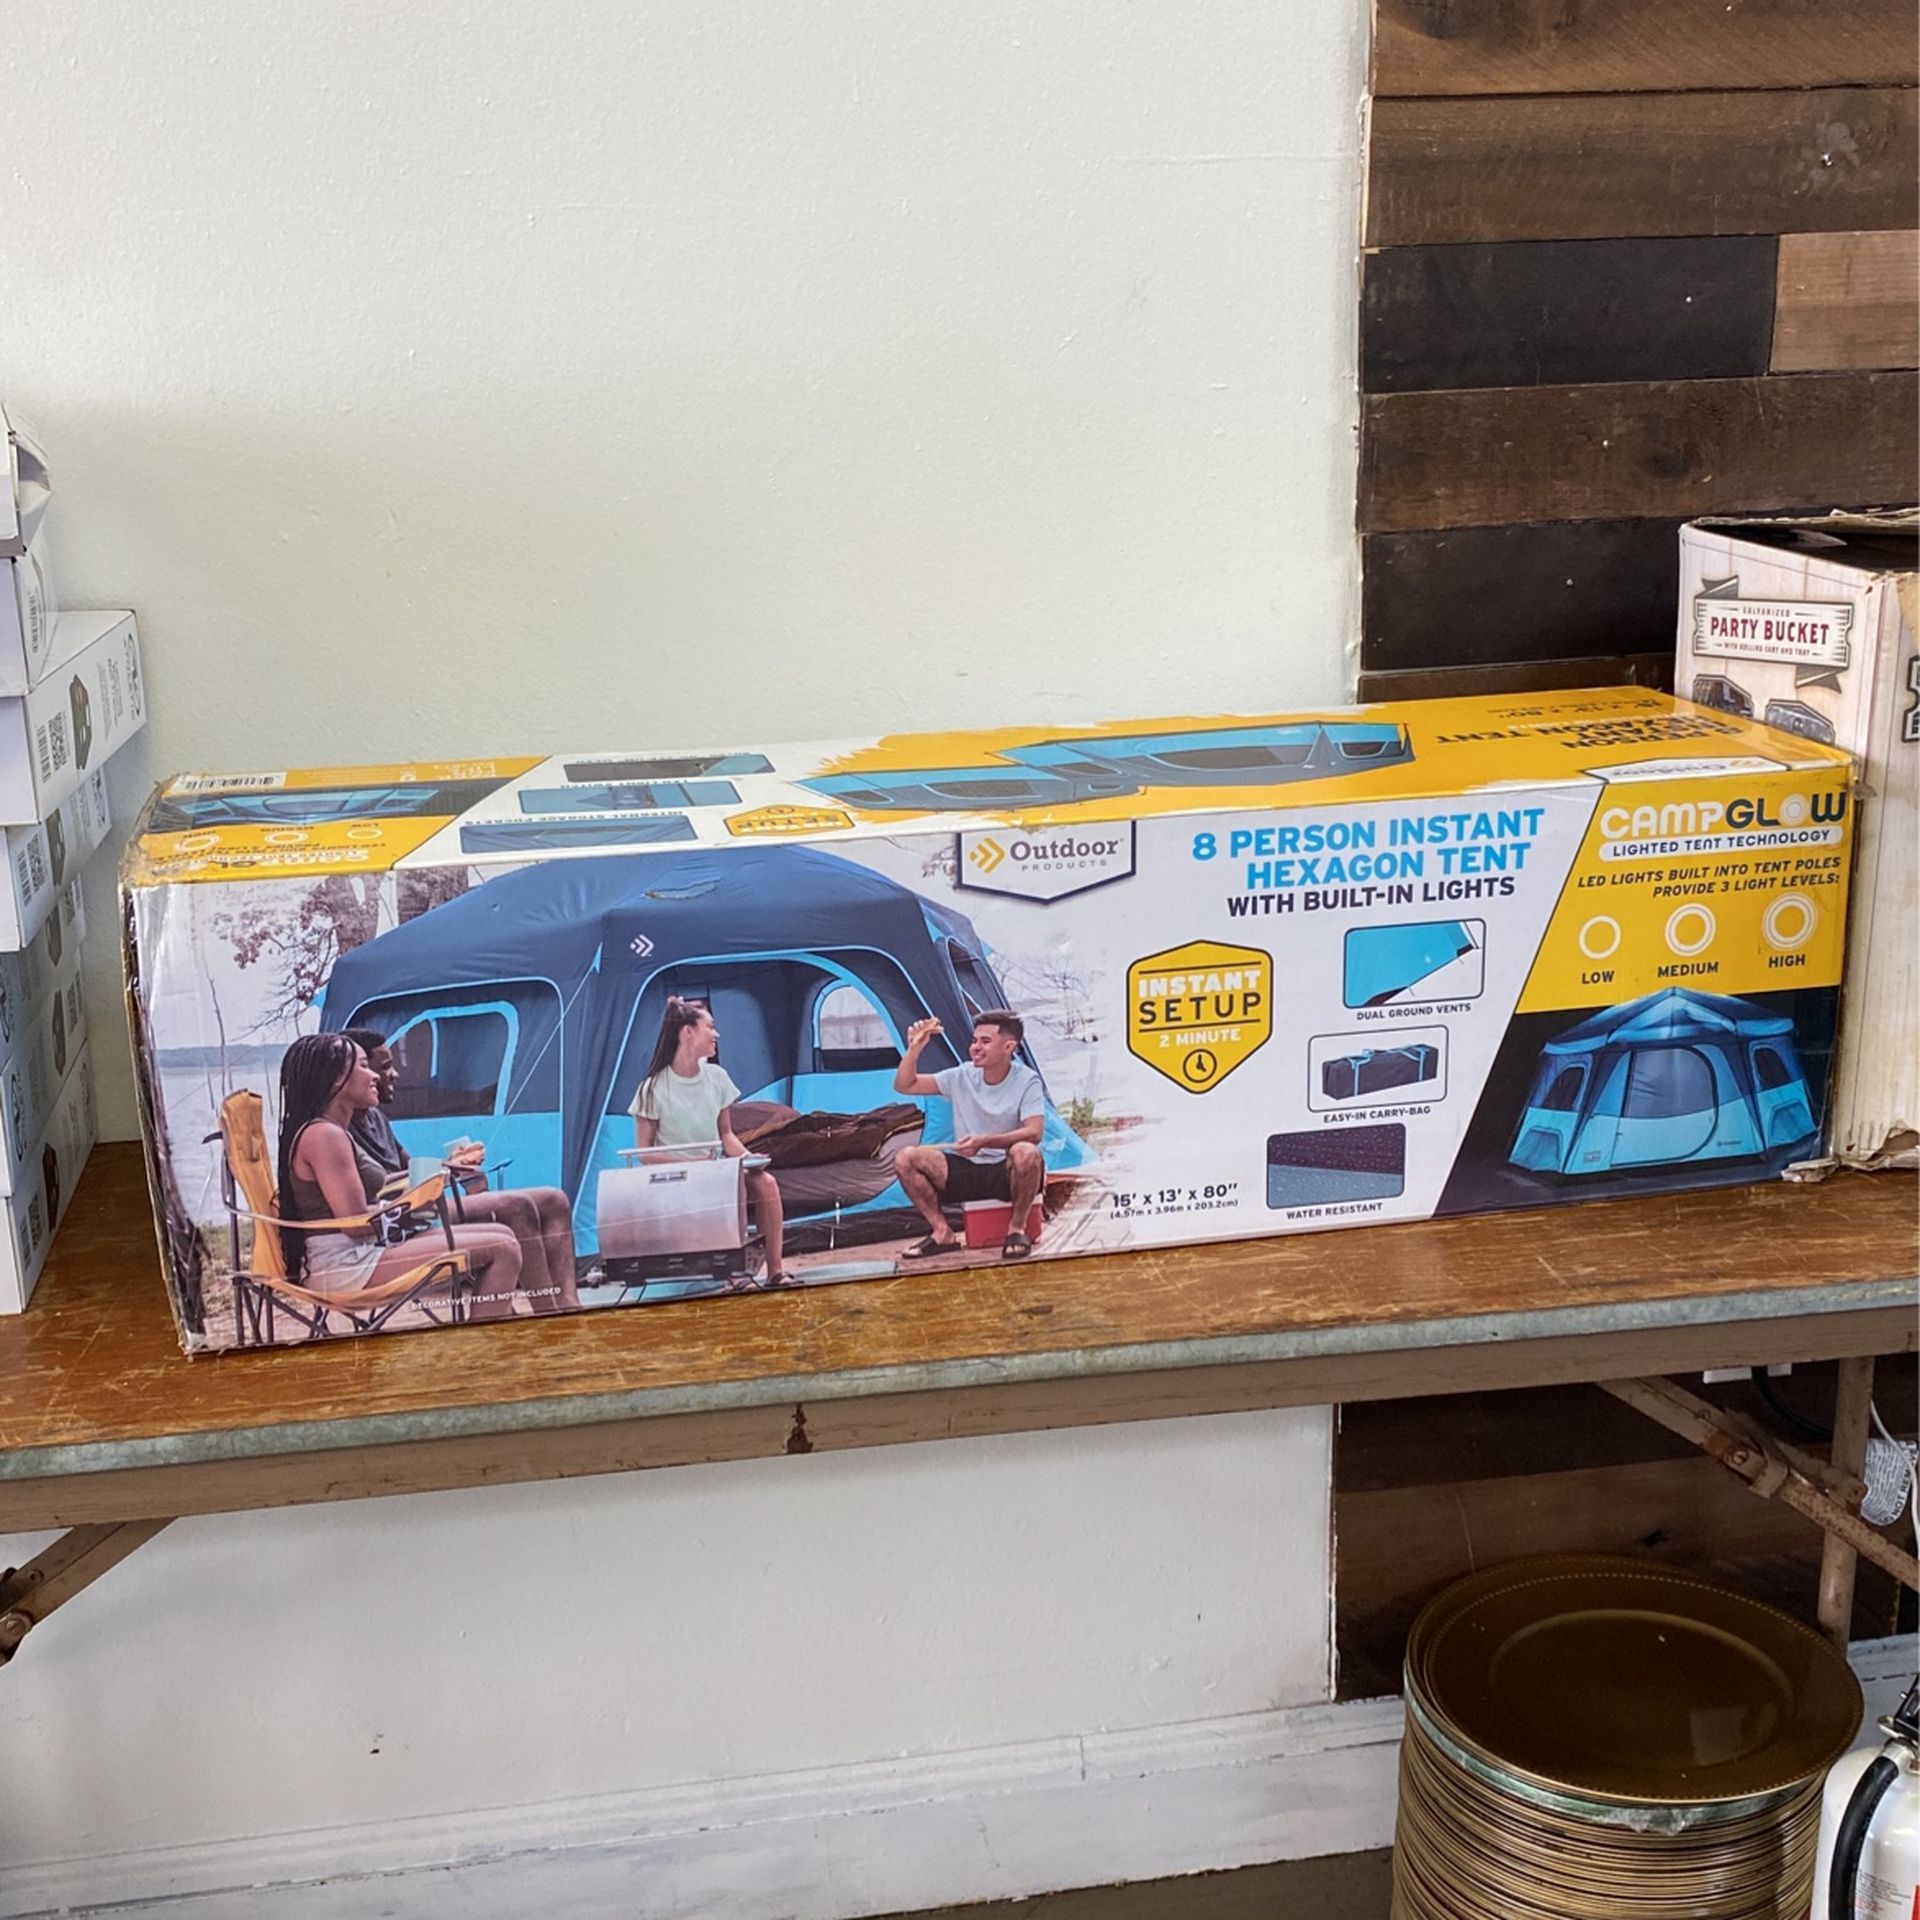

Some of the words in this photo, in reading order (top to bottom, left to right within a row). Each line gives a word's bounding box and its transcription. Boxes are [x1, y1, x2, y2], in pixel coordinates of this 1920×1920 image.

[1709, 616, 1759, 639] PARTY
[1763, 619, 1830, 645] BUCKET
[1435, 731, 1531, 744] TENT
[1561, 730, 1711, 749] PERSON
[1600, 791, 1848, 839] CAMPGLOW
[1192, 832, 1218, 862] 8
[1230, 821, 1376, 859] PERSON
[1389, 808, 1545, 847] INSTANT
[1612, 841, 1679, 857] LIGHTED
[1684, 837, 1721, 851] TENT
[1726, 828, 1831, 848] TECHNOLOGY
[1009, 837, 1119, 862] Outdoor
[1020, 859, 1108, 872] PRODUCTS
[1246, 851, 1424, 890] HEXAGON
[1436, 842, 1532, 875] TENT
[1577, 875, 1606, 889] LED
[1610, 870, 1664, 886] LIGHTS
[1668, 866, 1710, 881] BUILT
[1713, 863, 1749, 877] INTO
[1754, 860, 1792, 873] TENT
[1795, 856, 1841, 871] POLES
[1652, 883, 1716, 899] PROVIDE
[1720, 880, 1730, 893] 3
[1734, 877, 1777, 892] LIGHT
[1780, 872, 1841, 887] LEVELS:
[1227, 892, 1295, 918] WITH
[1303, 883, 1414, 912] BUILT-IN
[1422, 876, 1516, 903] LIGHTS
[1656, 961, 1720, 978] MEDIUM
[1768, 954, 1806, 969] HIGH
[1138, 969, 1262, 998] INSTANT
[1581, 970, 1615, 985] LOW
[1139, 992, 1262, 1025] SETUP
[1356, 1010, 1385, 1021] DUAL
[1388, 1006, 1433, 1018] GROUND
[1436, 1003, 1472, 1015] VENTS
[1159, 1034, 1170, 1048] 2
[1175, 1028, 1241, 1046] MINUTE
[1323, 1111, 1367, 1124] EASY-IN
[1369, 1106, 1431, 1120] CARRY-BAG
[1112, 1192, 1138, 1208] 15'
[1143, 1194, 1153, 1205] x
[1158, 1189, 1182, 1204] 13'
[1188, 1190, 1198, 1201] x
[1154, 1204, 1185, 1215] 3.96m
[1194, 1198, 1239, 1210] 203.2cm)
[1285, 1207, 1323, 1221] WATER
[1325, 1202, 1384, 1217] RESISTANT
[468, 1293, 497, 1305] ITEMS
[497, 1291, 516, 1301] NOT
[517, 1286, 562, 1299] INCLUDED
